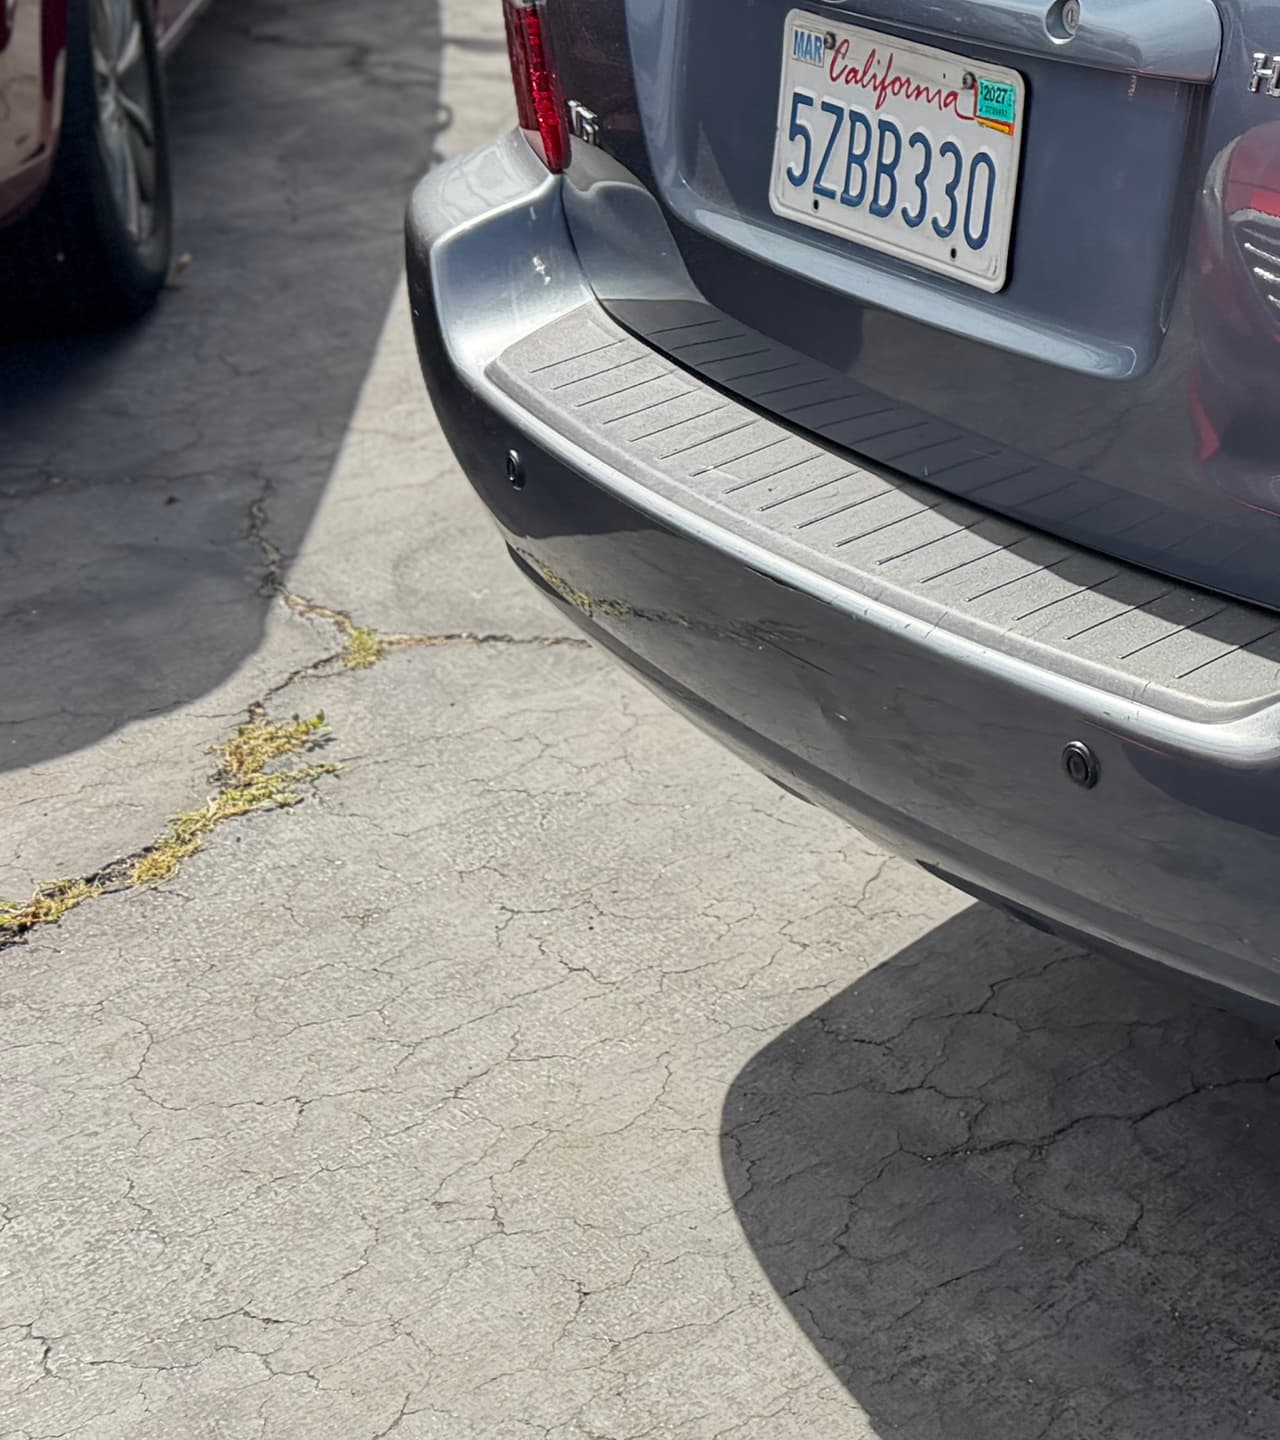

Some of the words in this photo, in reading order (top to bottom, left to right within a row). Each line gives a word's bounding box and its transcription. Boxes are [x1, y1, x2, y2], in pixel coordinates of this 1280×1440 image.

[792, 29, 824, 63] MAR
[829, 38, 978, 121] California
[983, 85, 1009, 105] 2027
[785, 91, 997, 251] 5ZBB330
